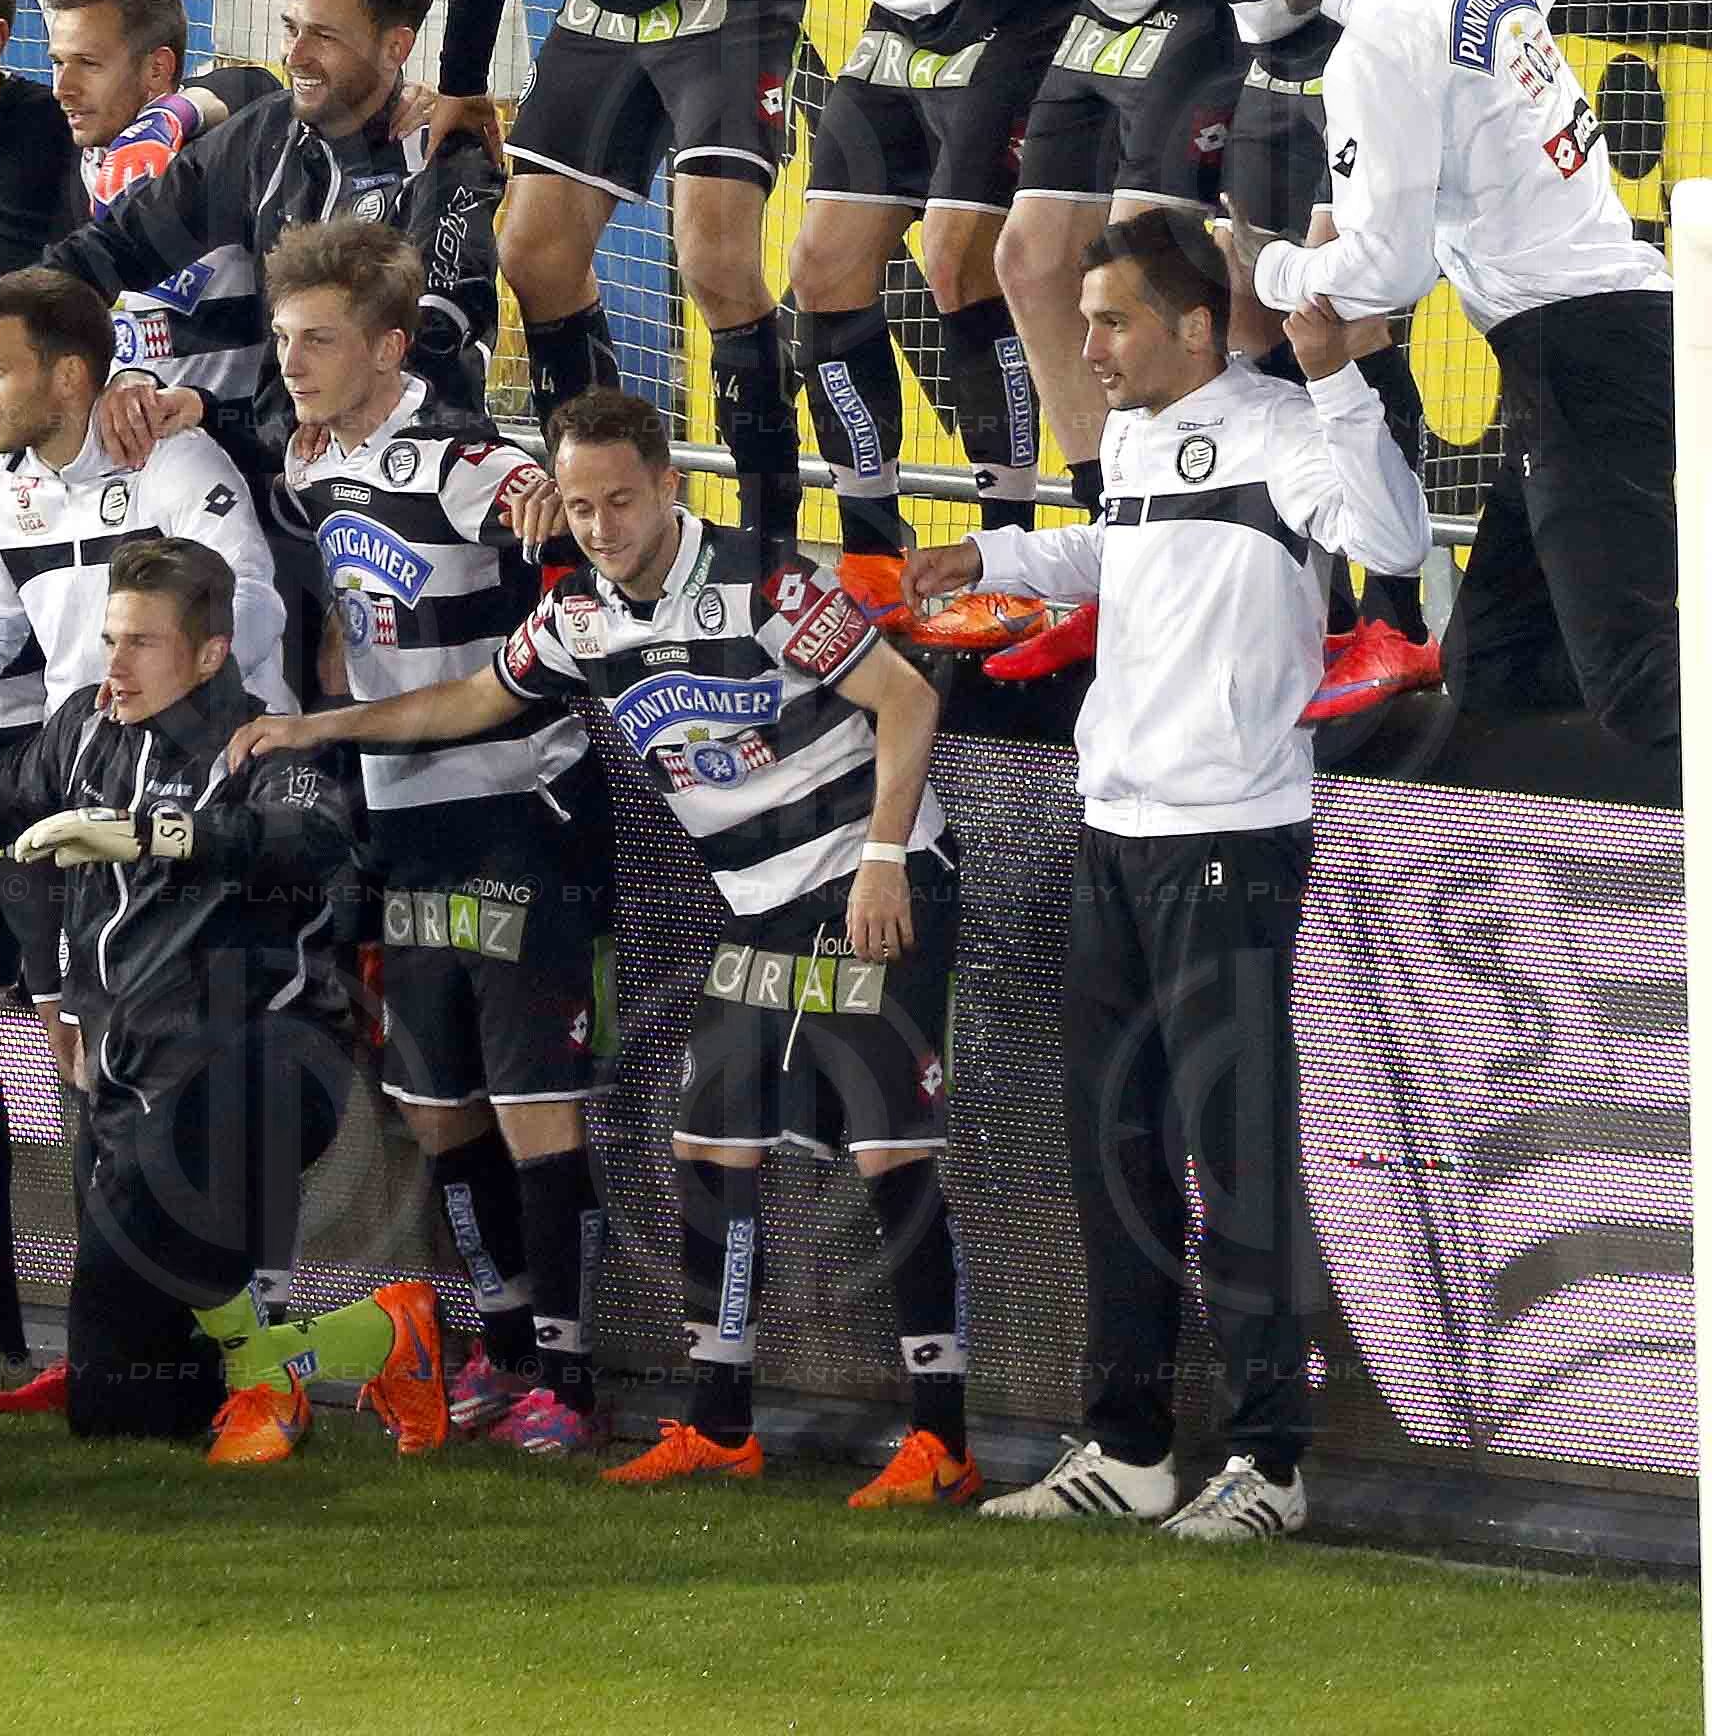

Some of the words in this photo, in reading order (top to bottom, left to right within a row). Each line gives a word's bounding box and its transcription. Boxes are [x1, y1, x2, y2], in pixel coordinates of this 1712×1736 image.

[621, 685, 771, 742] PUNTIGAMER
[1205, 863, 1223, 886] 13
[389, 900, 512, 954] GRAZ
[710, 950, 874, 1010] GRAZ
